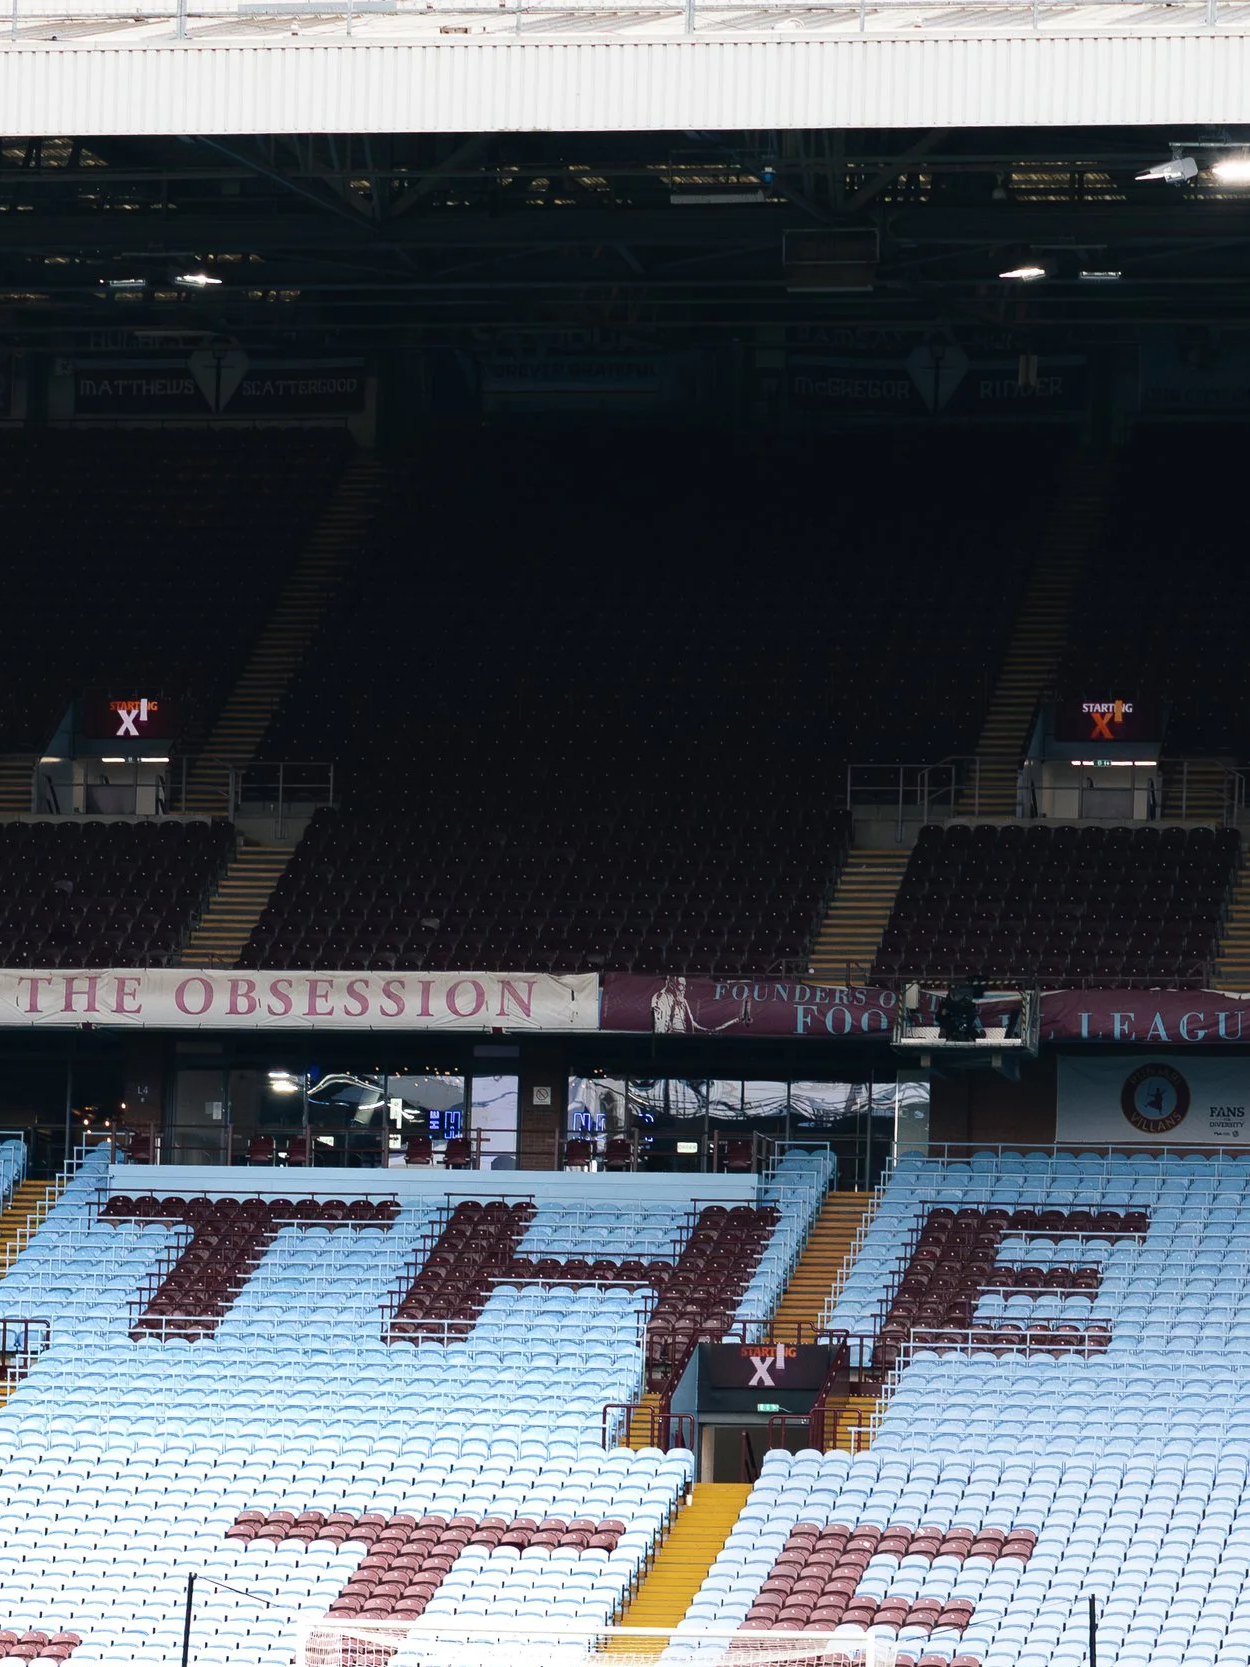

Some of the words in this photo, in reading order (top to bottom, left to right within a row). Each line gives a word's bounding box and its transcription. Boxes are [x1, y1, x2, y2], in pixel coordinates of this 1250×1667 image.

[80, 378, 195, 397] MATTHEWS
[242, 378, 357, 397] SCATTERGOOD
[17, 976, 143, 1014] THE
[173, 976, 538, 1019] OBSESSION
[714, 983, 867, 1006] FOUNDERS
[1129, 1111, 1183, 1132] VILLANS
[1210, 1106, 1245, 1117] FANS
[98, 1194, 1150, 1366] THE
